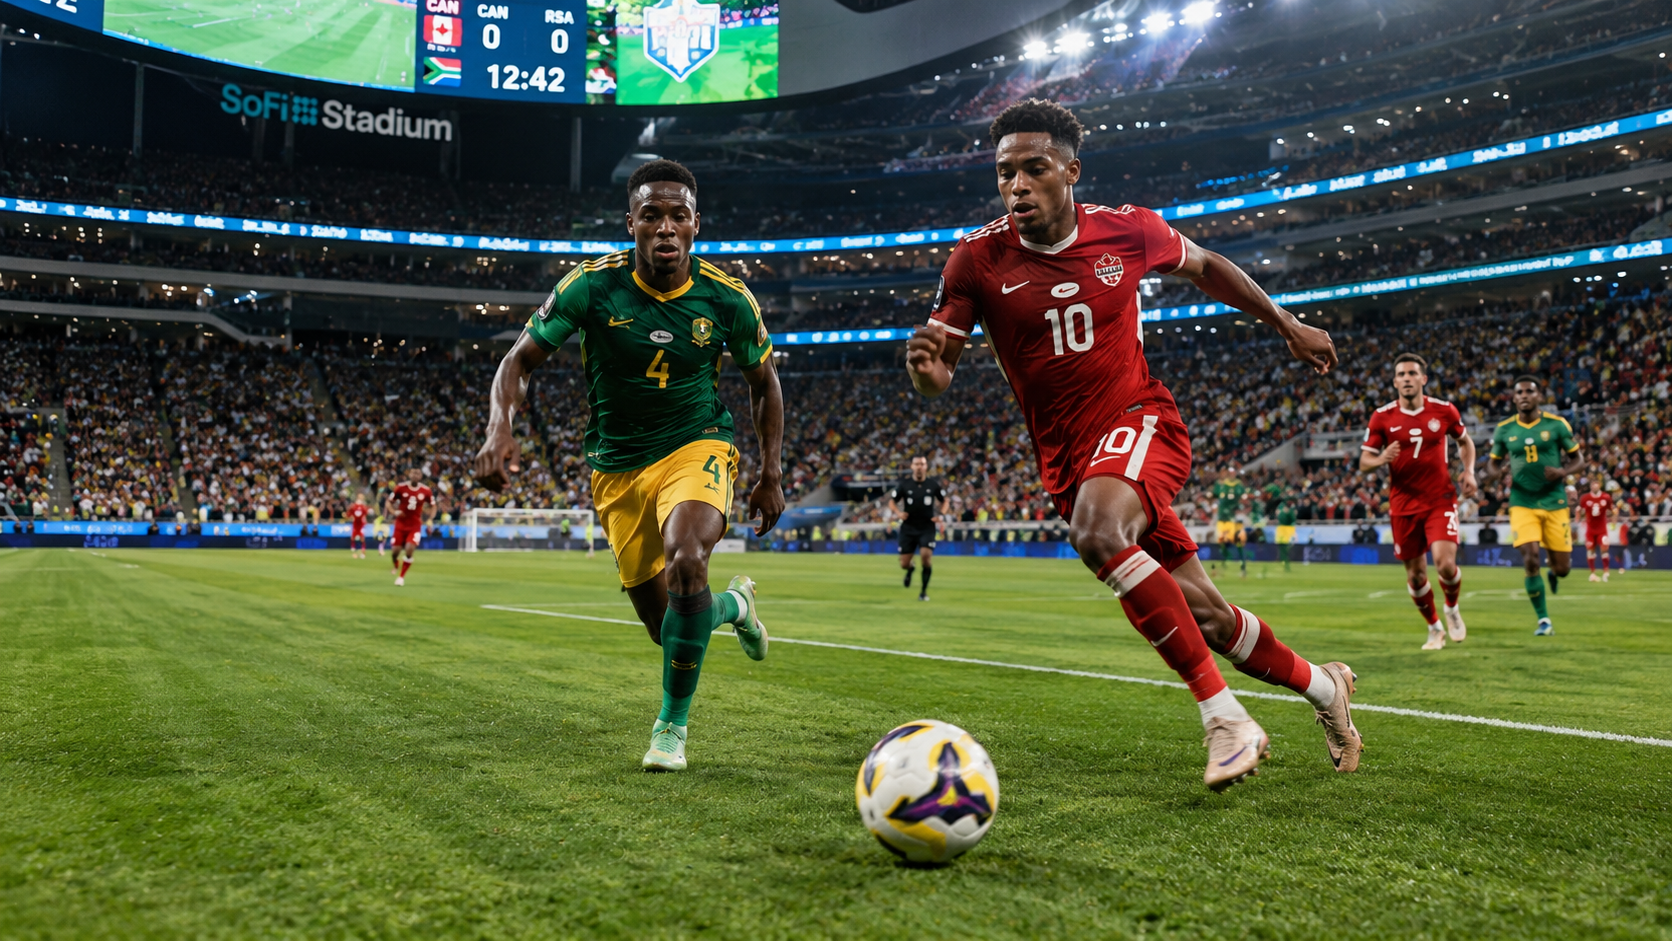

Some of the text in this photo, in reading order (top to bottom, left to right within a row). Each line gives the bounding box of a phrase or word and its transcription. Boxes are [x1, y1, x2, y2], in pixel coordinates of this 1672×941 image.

[426, 0, 460, 15] CAN
[477, 4, 575, 25] CAN RSA
[482, 23, 569, 54] 0 0
[486, 63, 566, 93] 12:42
[220, 83, 453, 142] SoFi Stadium
[1044, 303, 1095, 356] 10
[645, 349, 670, 389] 4
[1409, 436, 1424, 459] 7
[702, 454, 721, 485] 4
